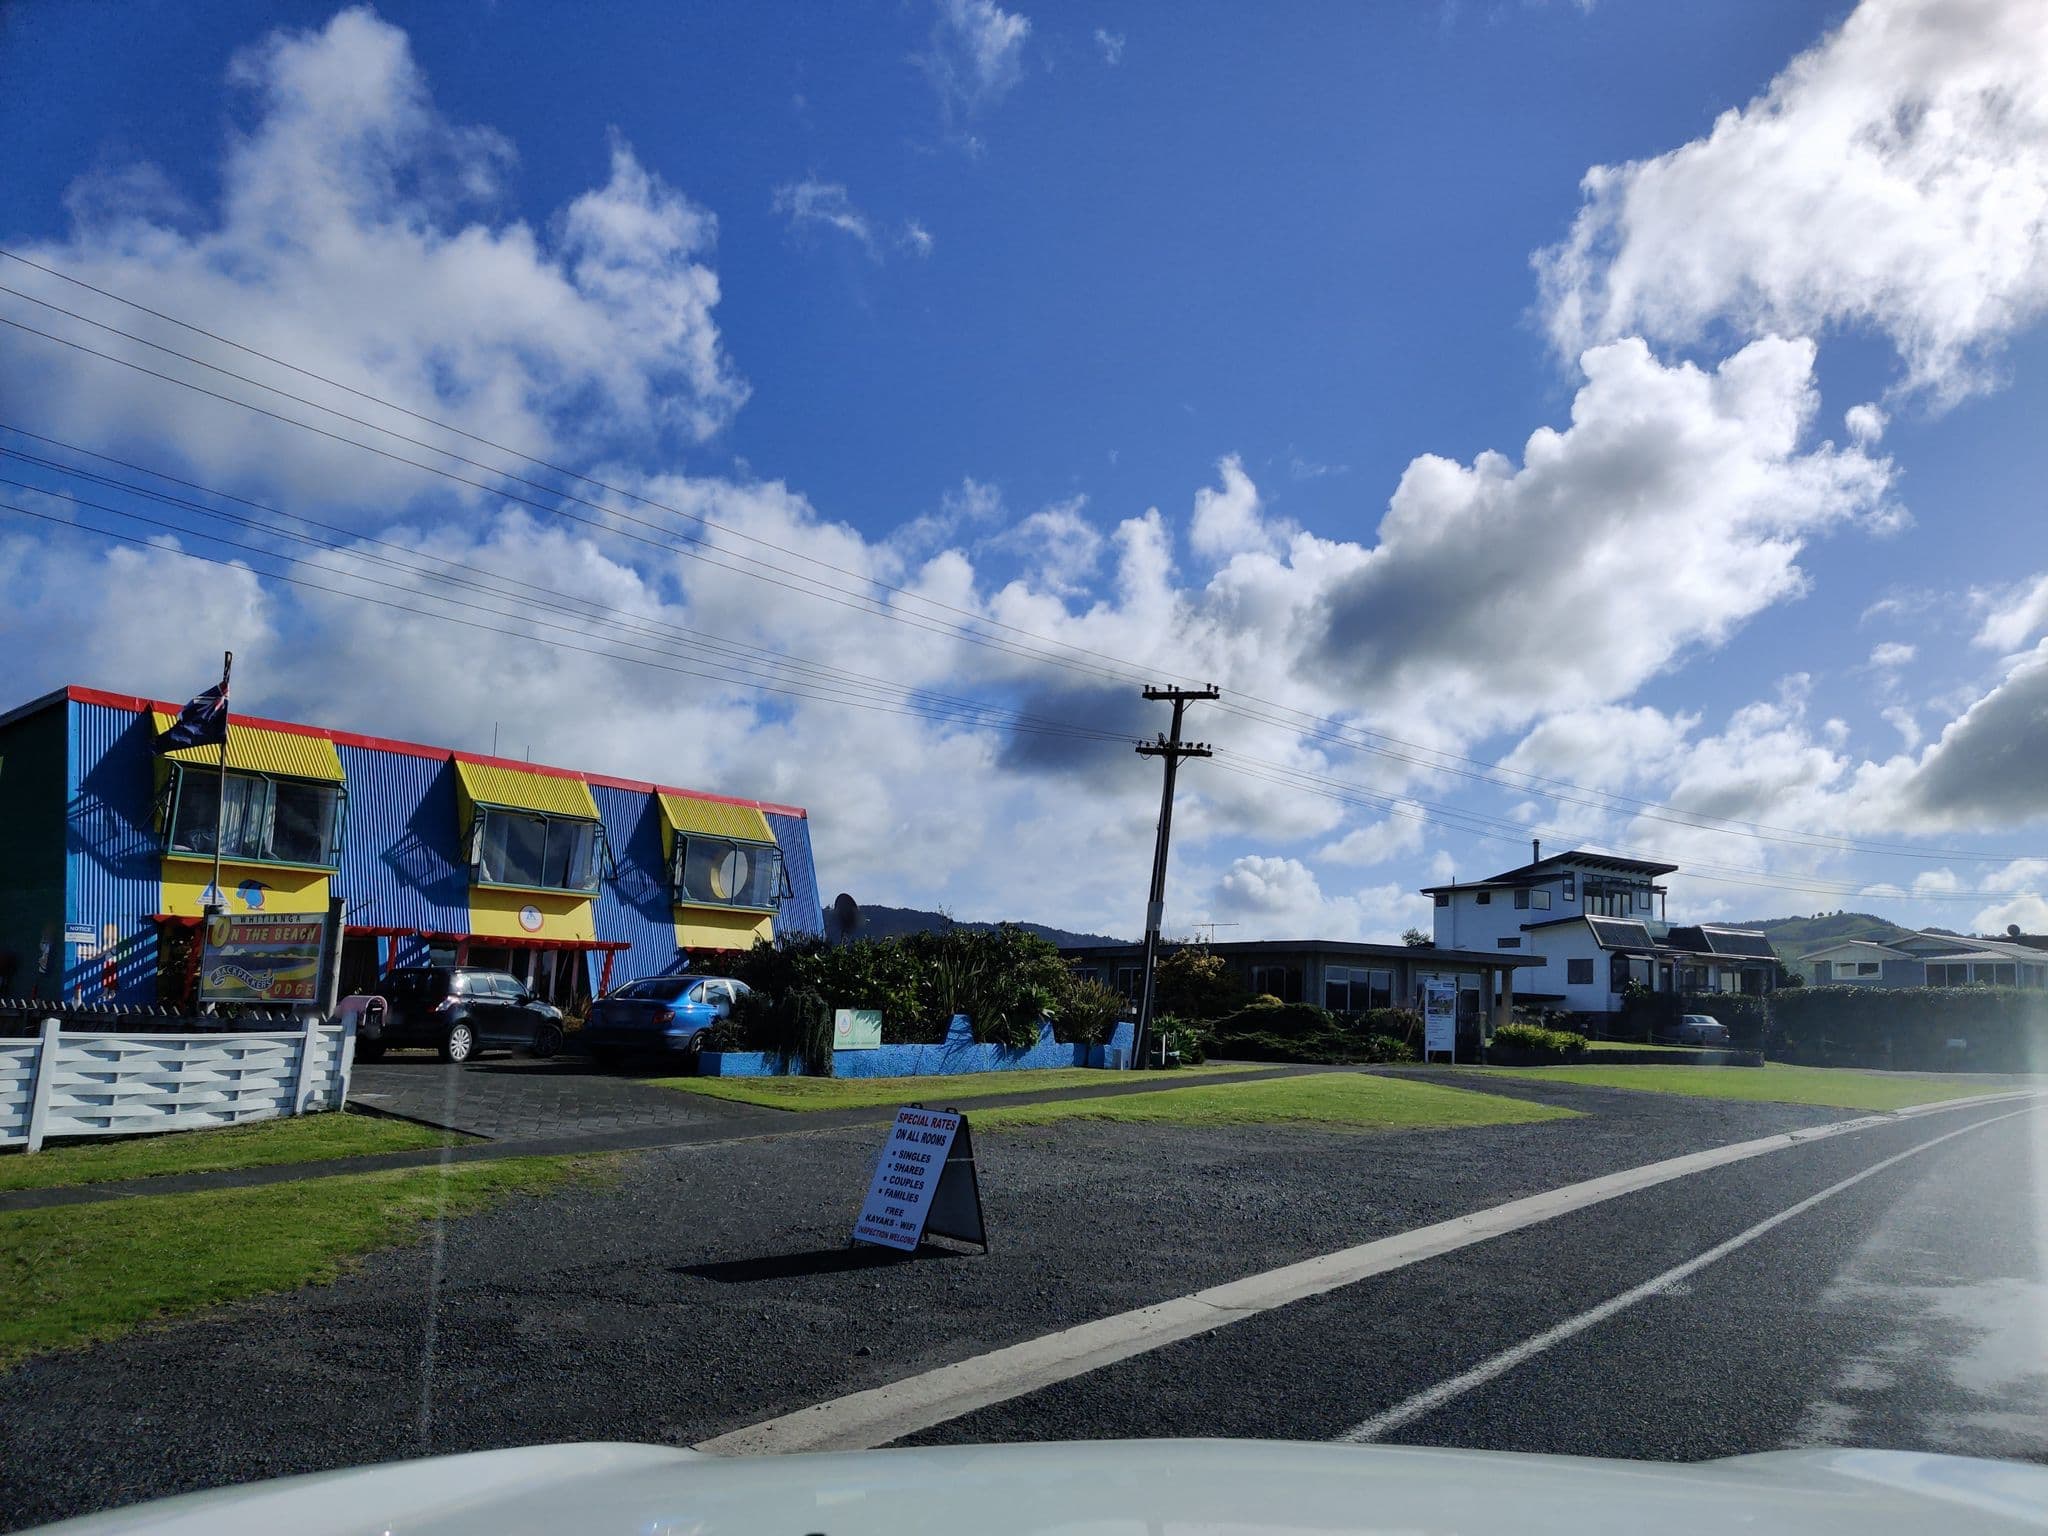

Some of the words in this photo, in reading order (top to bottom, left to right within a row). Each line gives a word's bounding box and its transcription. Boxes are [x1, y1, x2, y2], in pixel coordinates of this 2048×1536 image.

[240, 914, 302, 923] WHITIANGA
[212, 917, 240, 948] ON
[246, 928, 270, 941] THE
[274, 927, 317, 941] BEACH
[898, 1112, 930, 1127] SPECIAL
[930, 1117, 957, 1131] RATES
[895, 1129, 906, 1141] ON
[906, 1131, 920, 1143] ALL
[920, 1132, 947, 1147] ROOMS
[898, 1149, 932, 1164] SINGLES
[893, 1162, 925, 1176] SHARED
[889, 1175, 925, 1190] COUPLES
[884, 1187, 919, 1203] FAMILIES
[885, 1206, 905, 1217] FREE
[865, 1213, 894, 1227] KAYAKS
[900, 1221, 917, 1232] WIFI
[858, 1225, 889, 1239] INSPECTION
[888, 1232, 917, 1246] WELCOME
